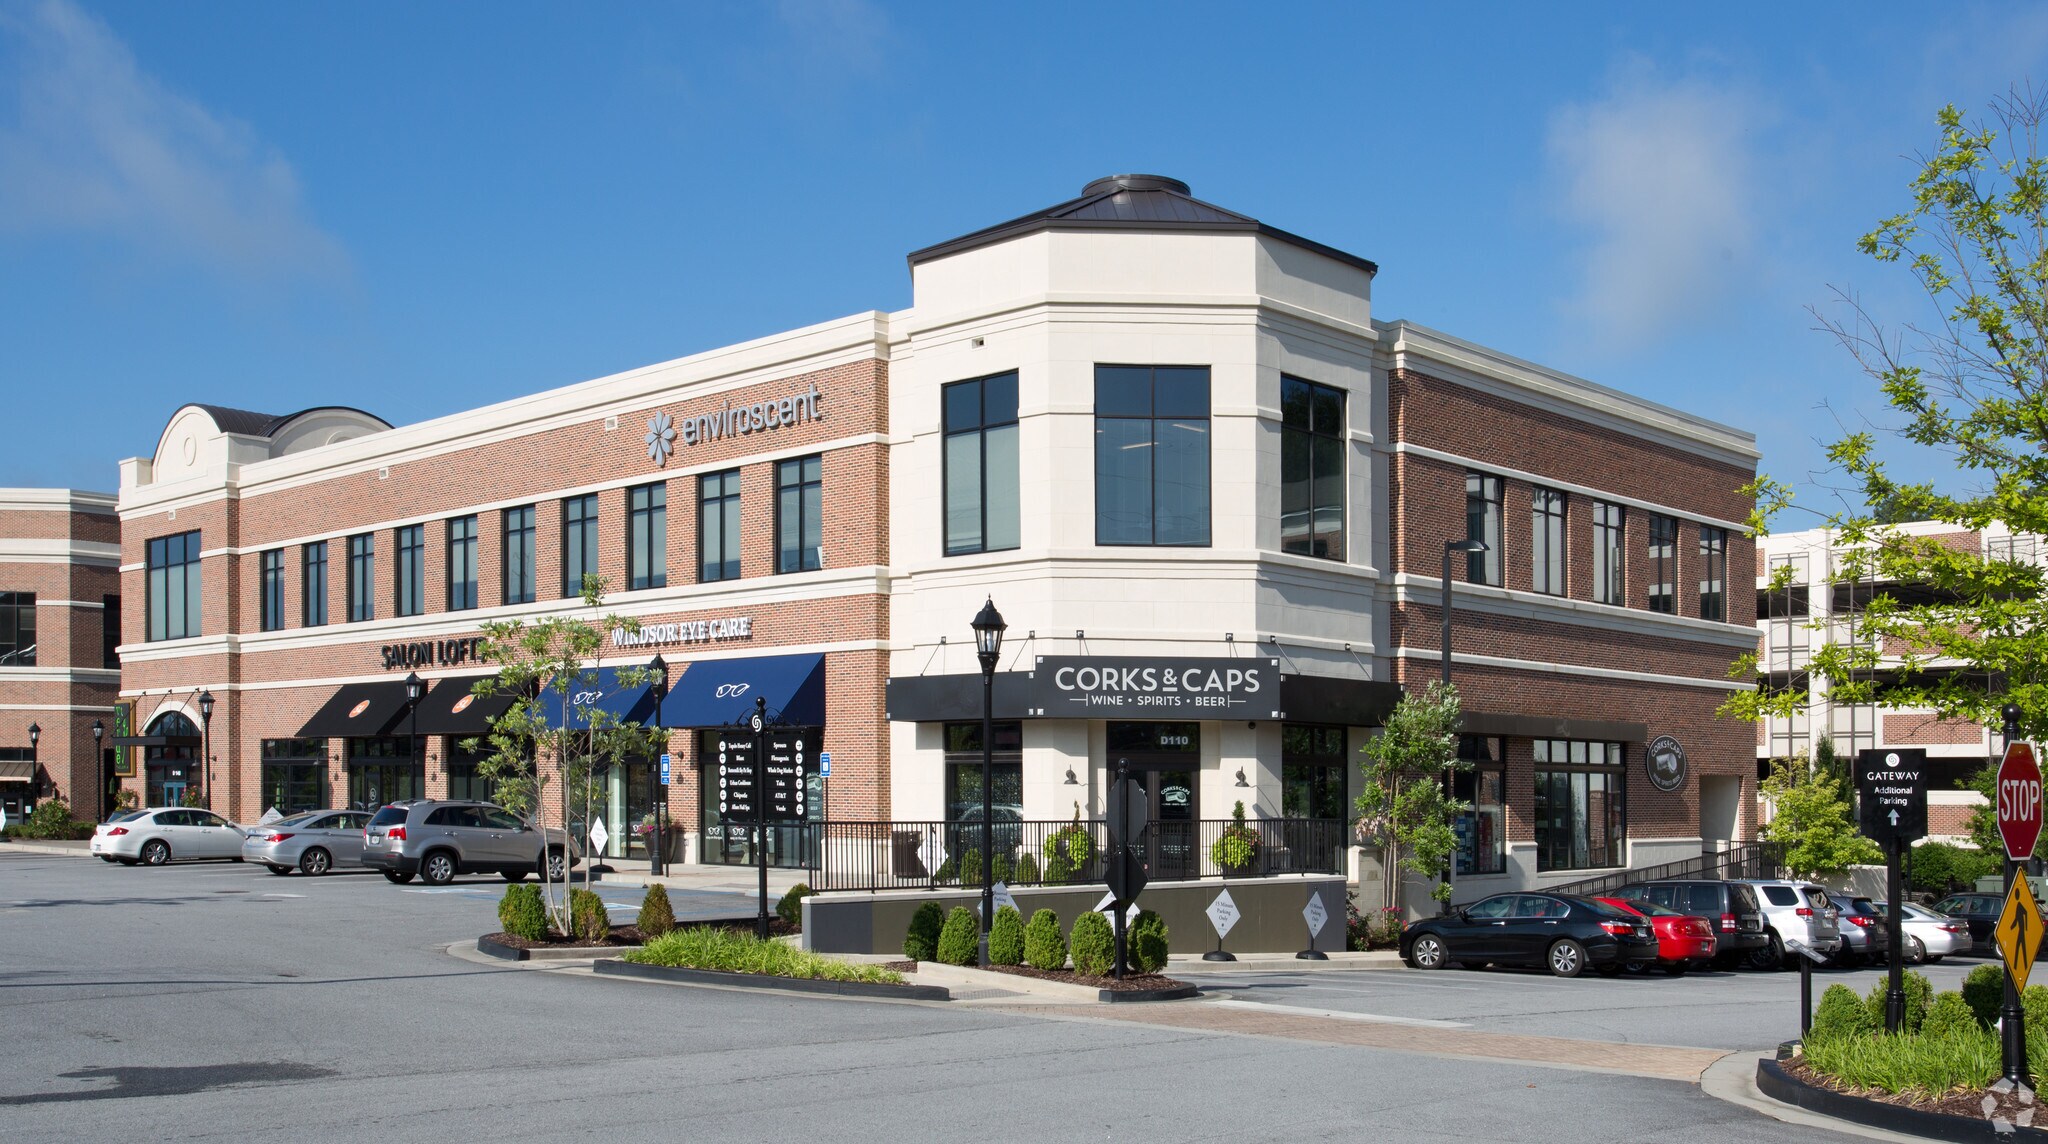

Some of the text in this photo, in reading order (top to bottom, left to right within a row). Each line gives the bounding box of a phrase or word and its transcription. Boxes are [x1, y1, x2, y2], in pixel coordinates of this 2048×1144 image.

[683, 383, 821, 444] enviroscent
[680, 621, 707, 641] EYE
[709, 617, 751, 638] CARE
[382, 641, 433, 669] SALON
[1091, 695, 1226, 706] WINE SPIRITS BEER
[1160, 736, 1188, 745] D110
[1867, 772, 1919, 781] GATEWAY
[1874, 786, 1912, 794] Additional
[1879, 797, 1907, 806] Parking
[2001, 779, 2040, 822] STOP
[1217, 908, 1231, 916] Parking
